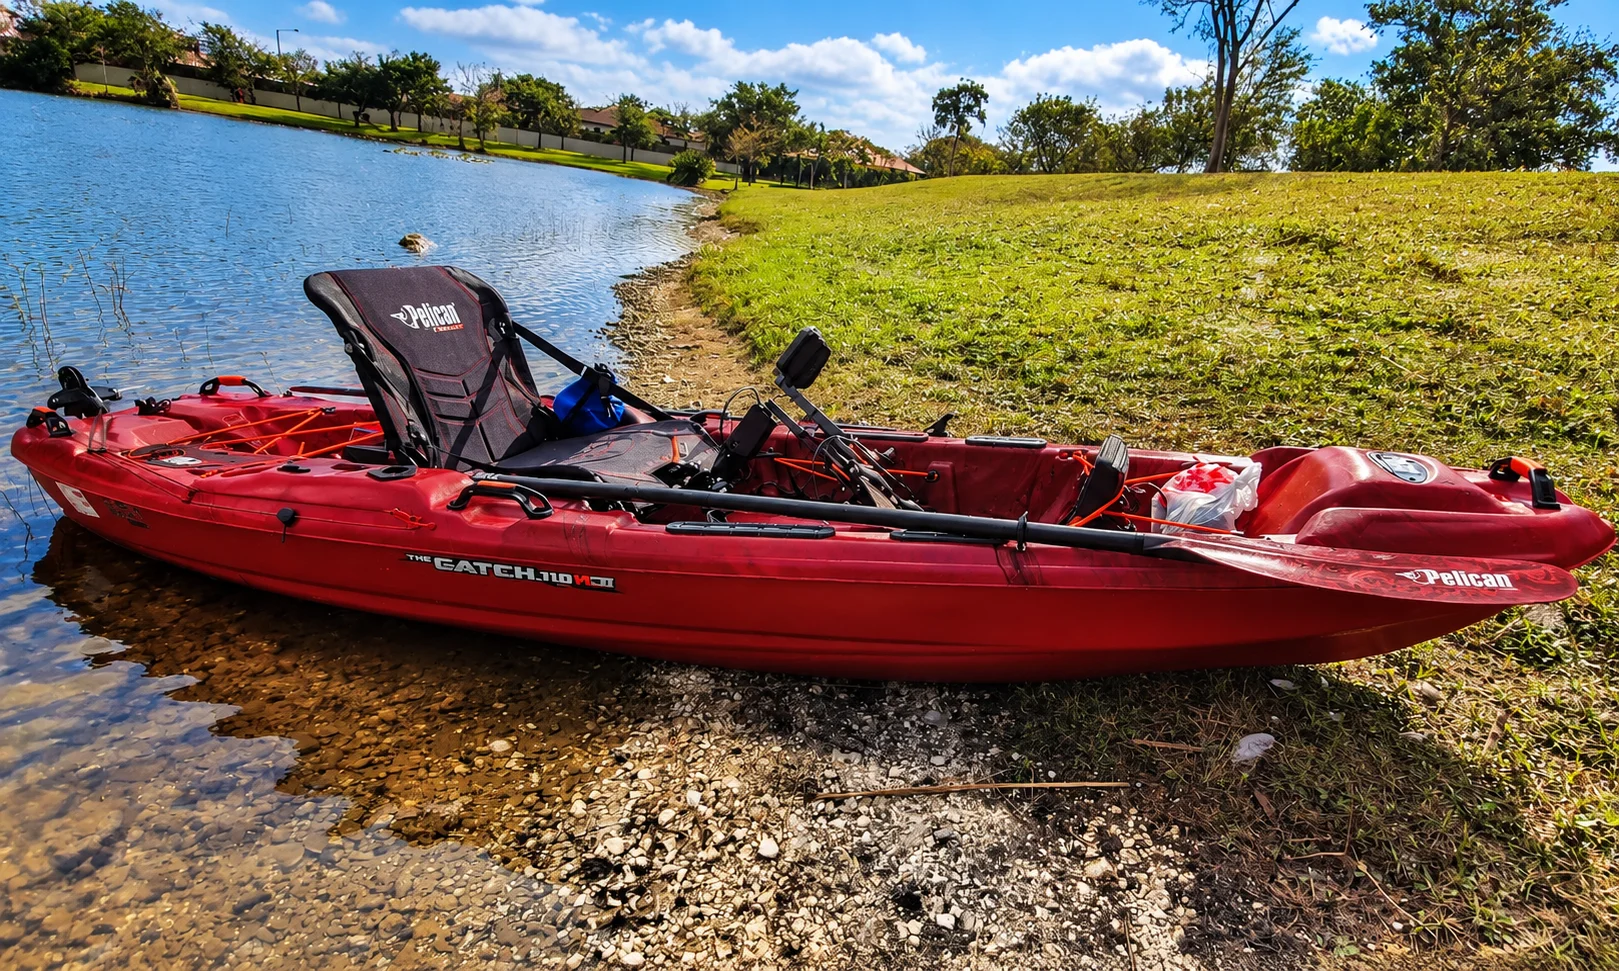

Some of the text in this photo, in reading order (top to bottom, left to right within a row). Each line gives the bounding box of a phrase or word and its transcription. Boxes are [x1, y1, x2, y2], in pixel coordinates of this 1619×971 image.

[401, 302, 461, 329] Pelican
[405, 553, 432, 563] THE
[1414, 568, 1513, 588] Pelican
